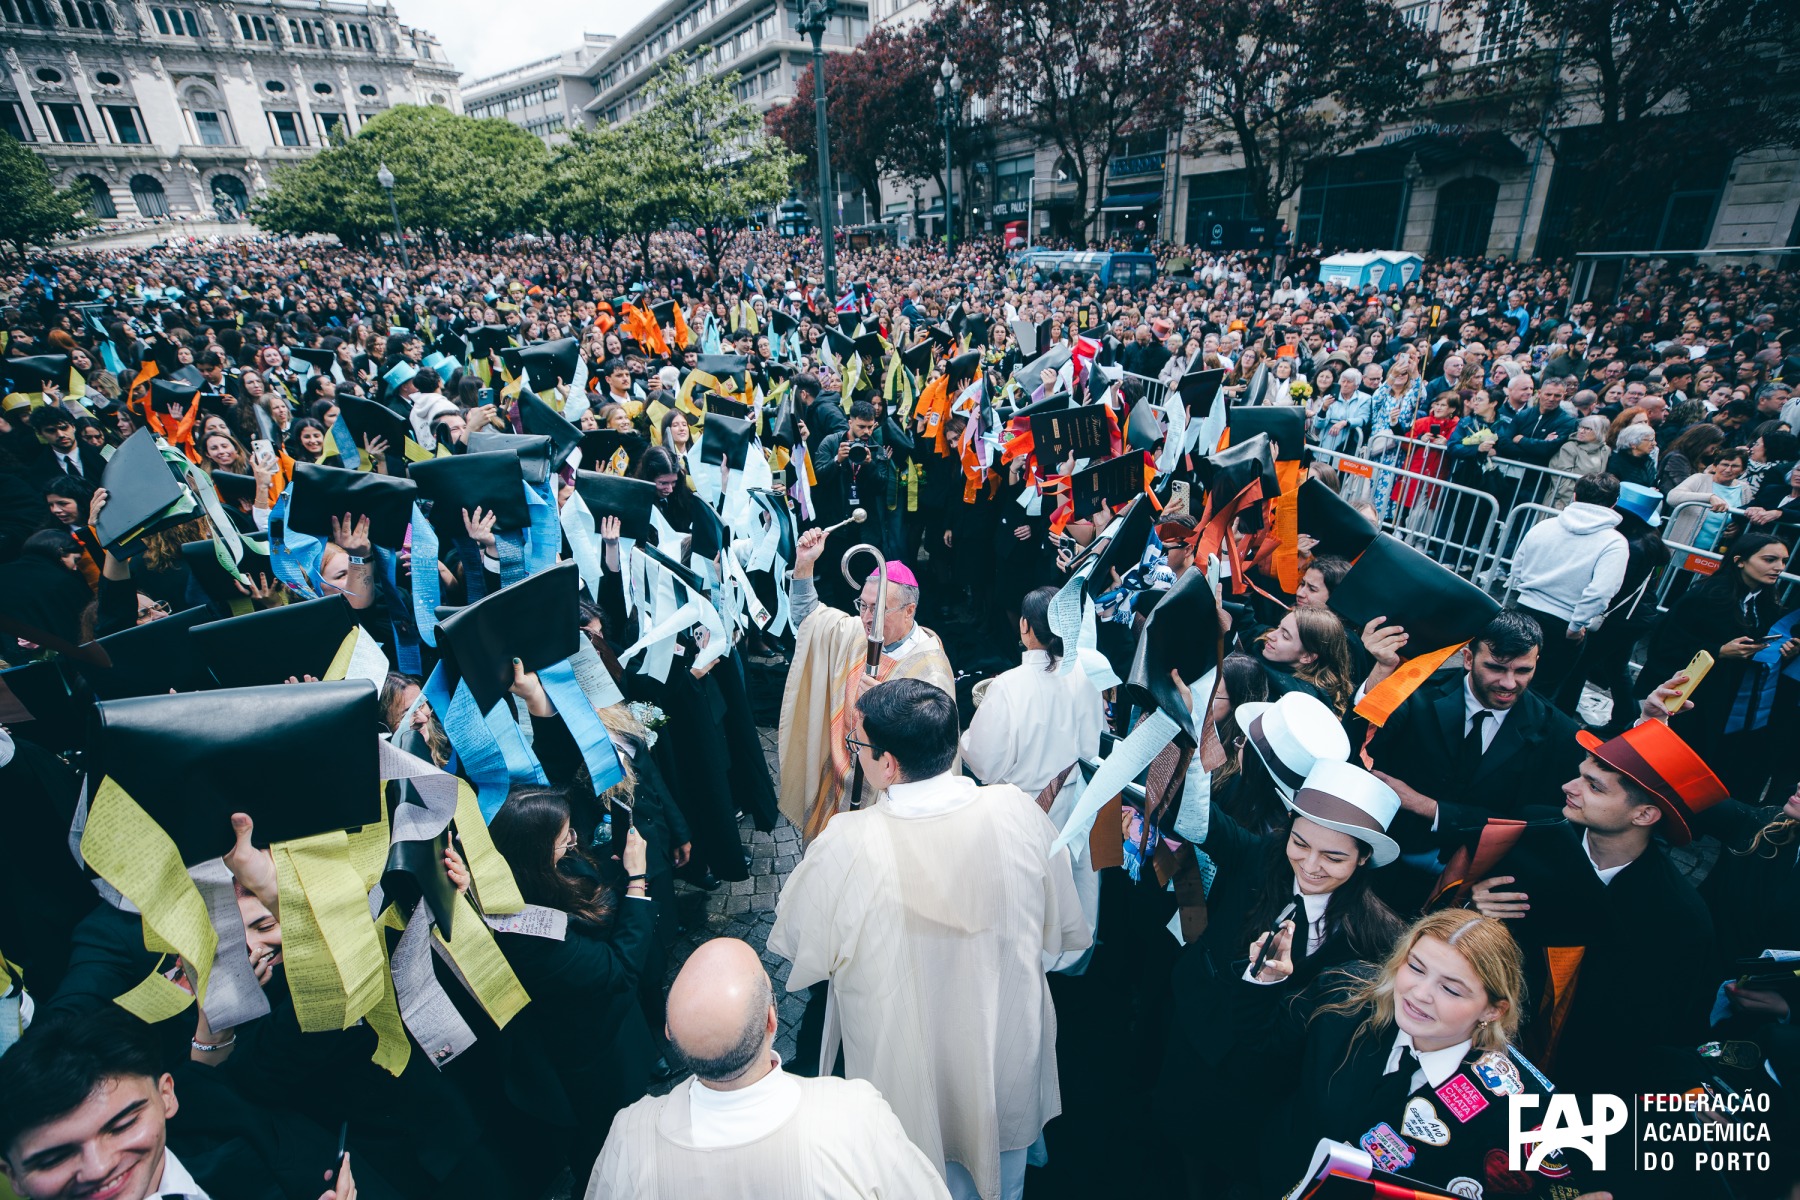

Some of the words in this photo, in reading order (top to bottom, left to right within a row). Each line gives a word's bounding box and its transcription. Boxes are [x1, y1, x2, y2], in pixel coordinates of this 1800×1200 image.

[993, 203, 1008, 216] HOTEL
[1445, 1087, 1471, 1116] CHATA
[1452, 1082, 1464, 1095] QUE
[1462, 1093, 1474, 1106] NÃO
[1460, 1082, 1481, 1103] MÃE
[1365, 1135, 1397, 1171] GOOGLE
